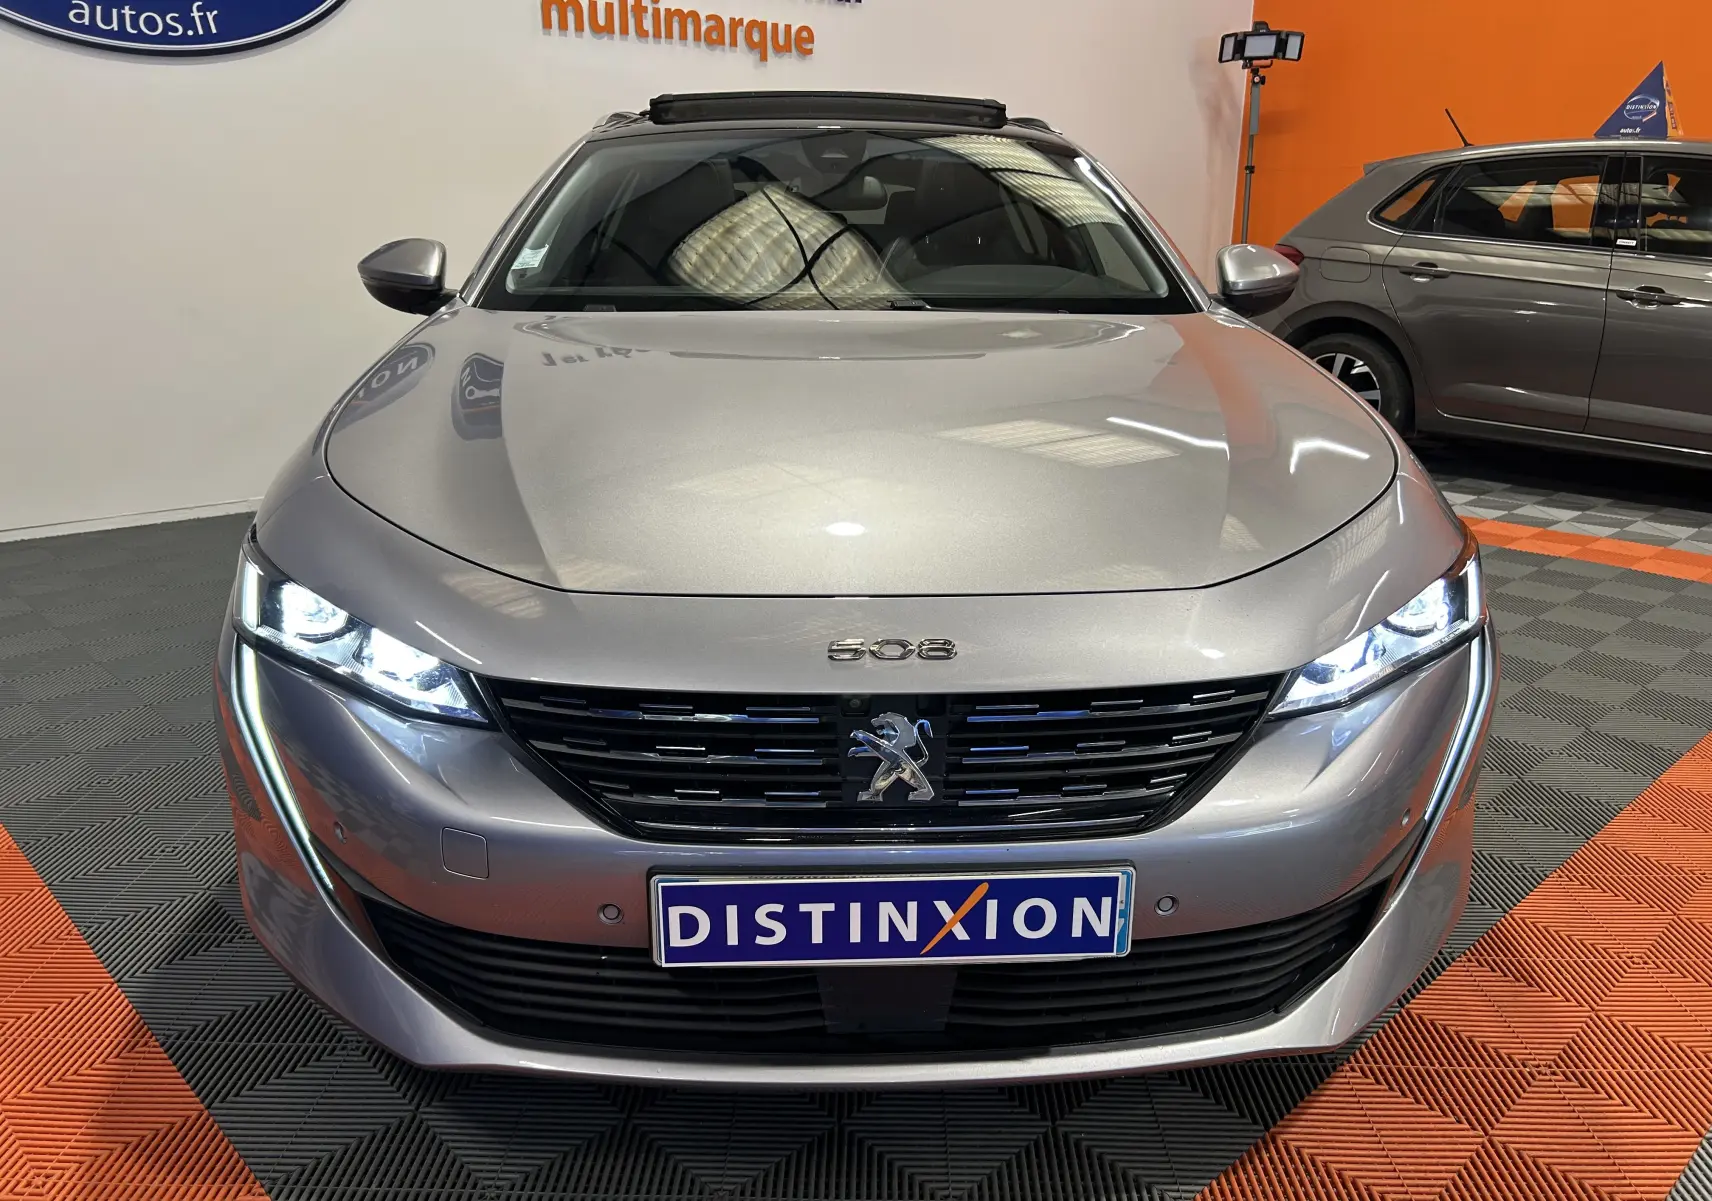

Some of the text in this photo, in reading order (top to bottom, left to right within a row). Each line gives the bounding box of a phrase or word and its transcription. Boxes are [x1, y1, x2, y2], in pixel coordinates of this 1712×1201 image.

[68, 0, 218, 37] autos.fr
[541, 0, 815, 62] multimarque
[827, 638, 958, 661] 508
[668, 883, 1113, 954] DISTINXION
